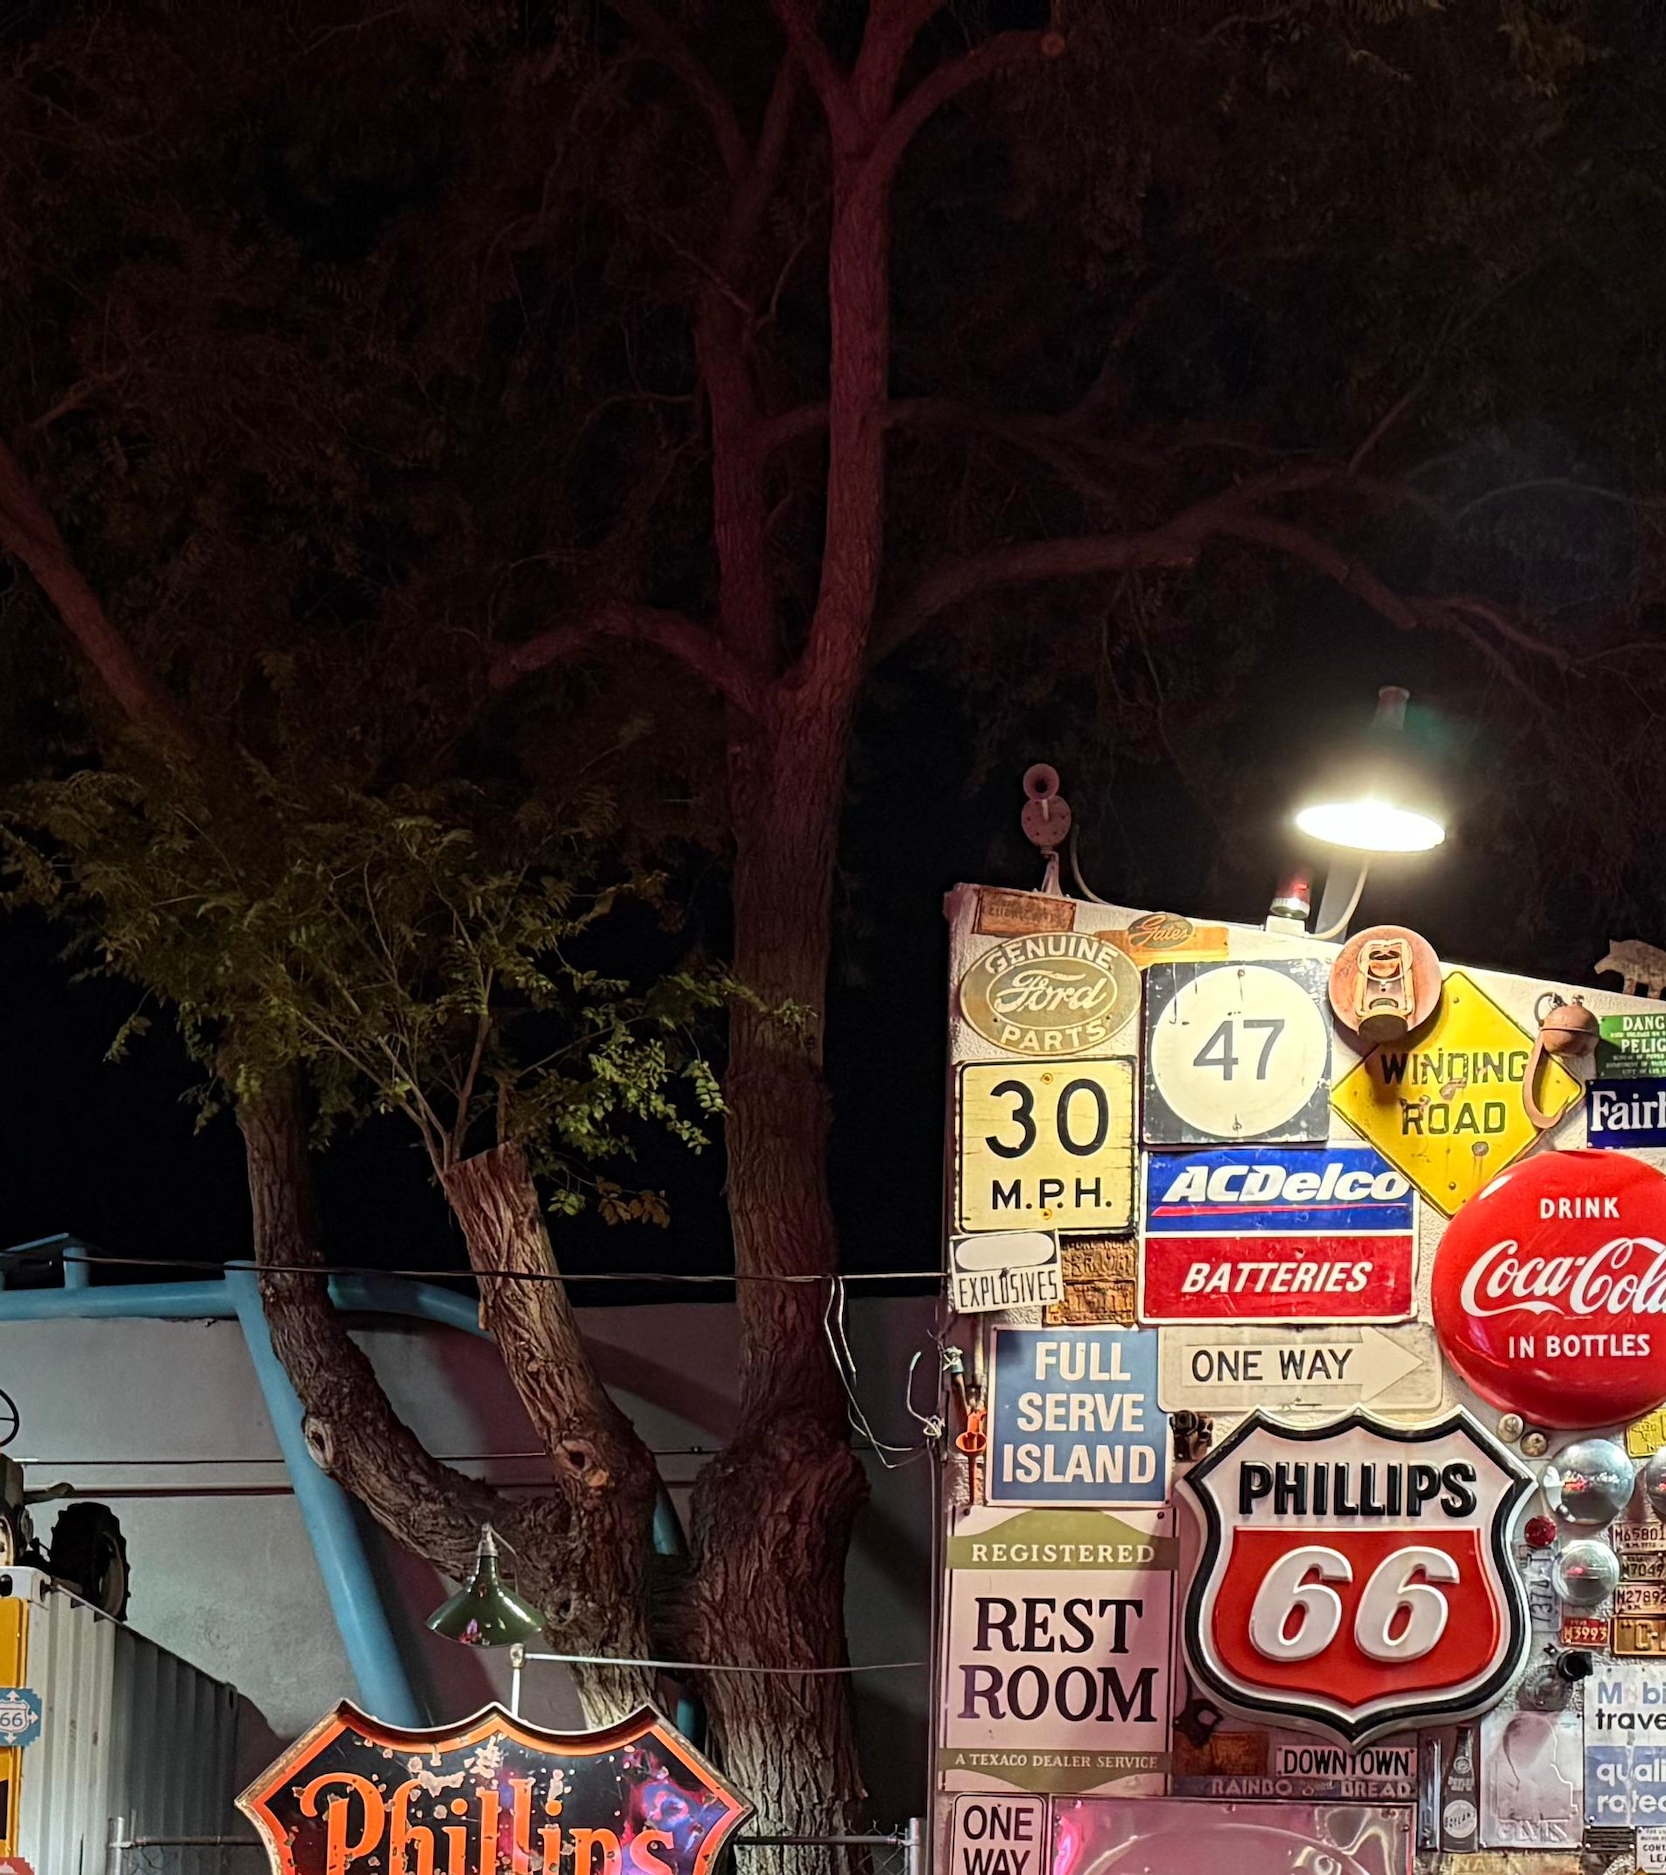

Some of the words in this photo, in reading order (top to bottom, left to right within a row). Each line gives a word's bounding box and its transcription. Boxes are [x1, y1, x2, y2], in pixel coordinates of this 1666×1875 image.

[986, 934, 1119, 976] GENUINE
[994, 969, 1107, 1014] Ford
[1000, 1018, 1109, 1052] PARTS
[1193, 1019, 1286, 1083] 47
[985, 1078, 1109, 1159] 30
[992, 1179, 1113, 1210] M.P.H.
[1161, 1163, 1412, 1204] ACDelco
[1540, 1197, 1620, 1219] DRINK
[1181, 1261, 1374, 1293] BATTERIES
[1035, 1341, 1131, 1381] FULL
[1191, 1350, 1264, 1382] ONE
[1279, 1348, 1354, 1380] WAY
[1509, 1337, 1533, 1358] IN
[1546, 1335, 1650, 1358] BOTTLES
[1017, 1393, 1144, 1433] SERVE
[1002, 1443, 1156, 1484] ISLAND
[1239, 1461, 1477, 1517] PHILLIPS
[971, 1544, 1156, 1565] REGISTERED
[1248, 1545, 1460, 1664] 66
[972, 1597, 1143, 1654] REST
[957, 1664, 1160, 1723] ROOM
[955, 1754, 966, 1766] A
[970, 1755, 1028, 1768] TEXACO
[1032, 1755, 1092, 1769] DEALER
[1096, 1756, 1158, 1770] SERVICE
[1283, 1749, 1411, 1777] DOWNTOWN
